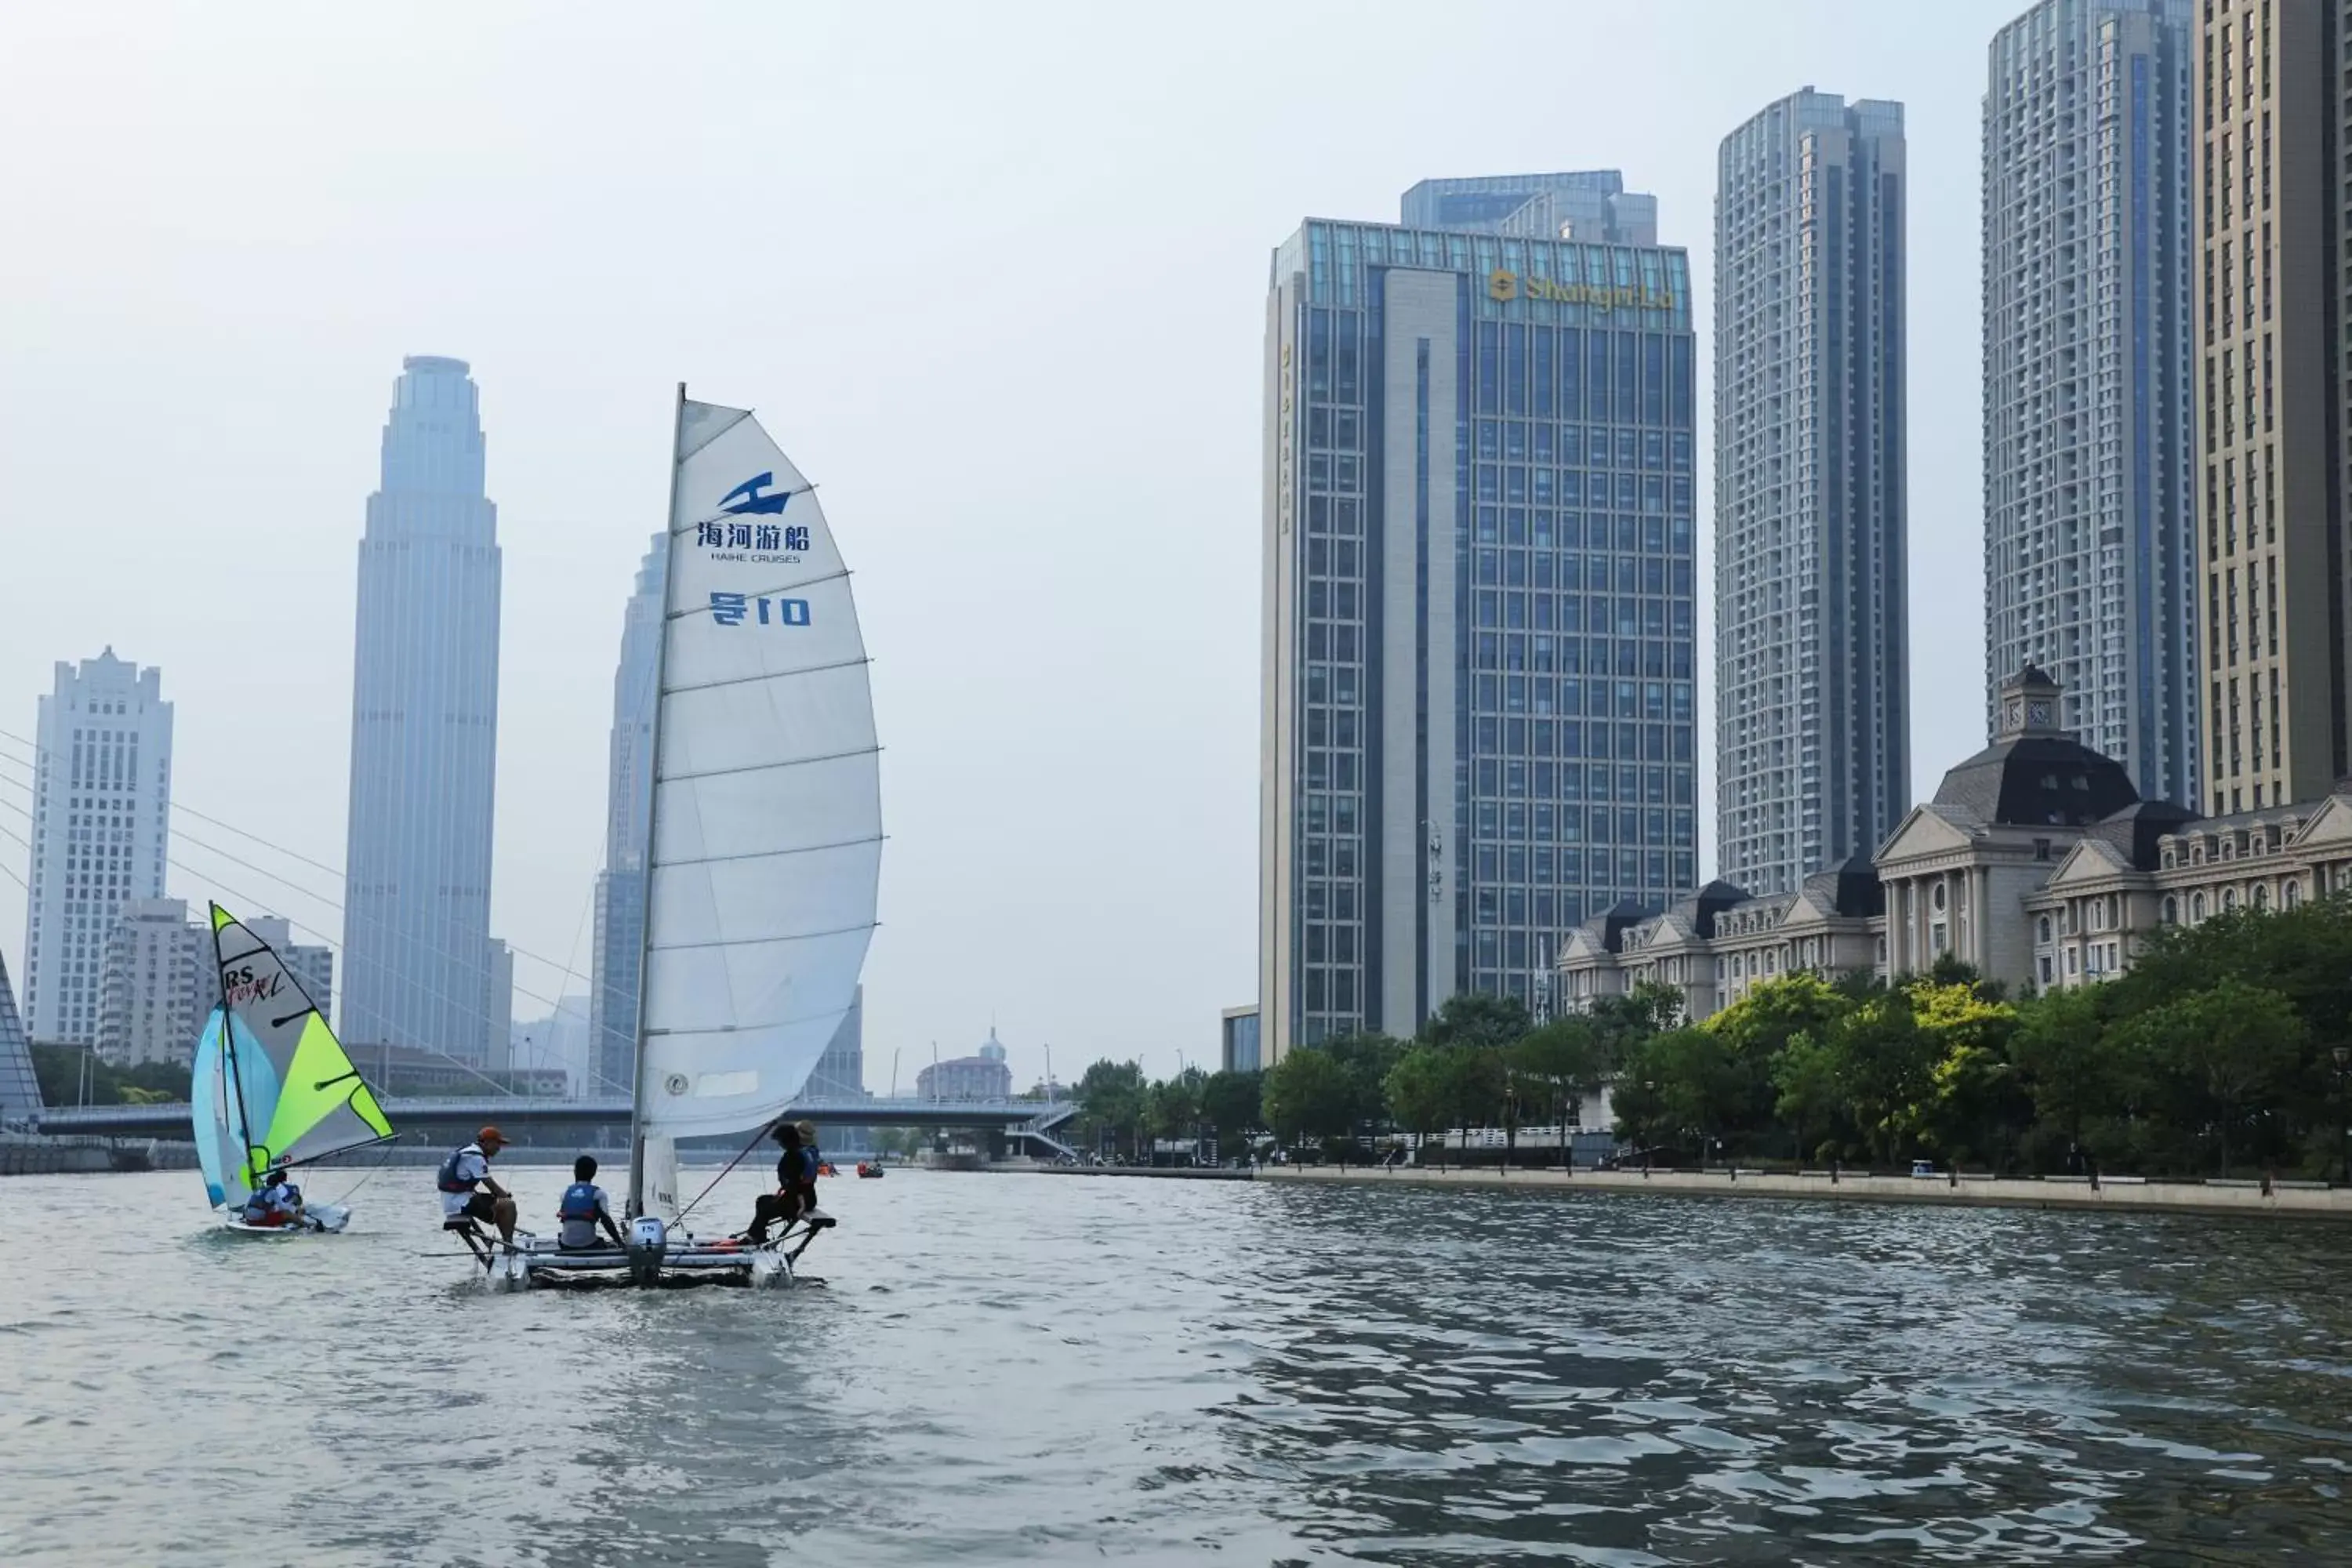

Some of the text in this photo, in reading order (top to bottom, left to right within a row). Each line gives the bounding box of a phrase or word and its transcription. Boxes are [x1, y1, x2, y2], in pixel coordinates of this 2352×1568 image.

[697, 521, 809, 550] 海河游船
[711, 552, 801, 564] HAIHE CRUISES
[225, 965, 253, 989] RS
